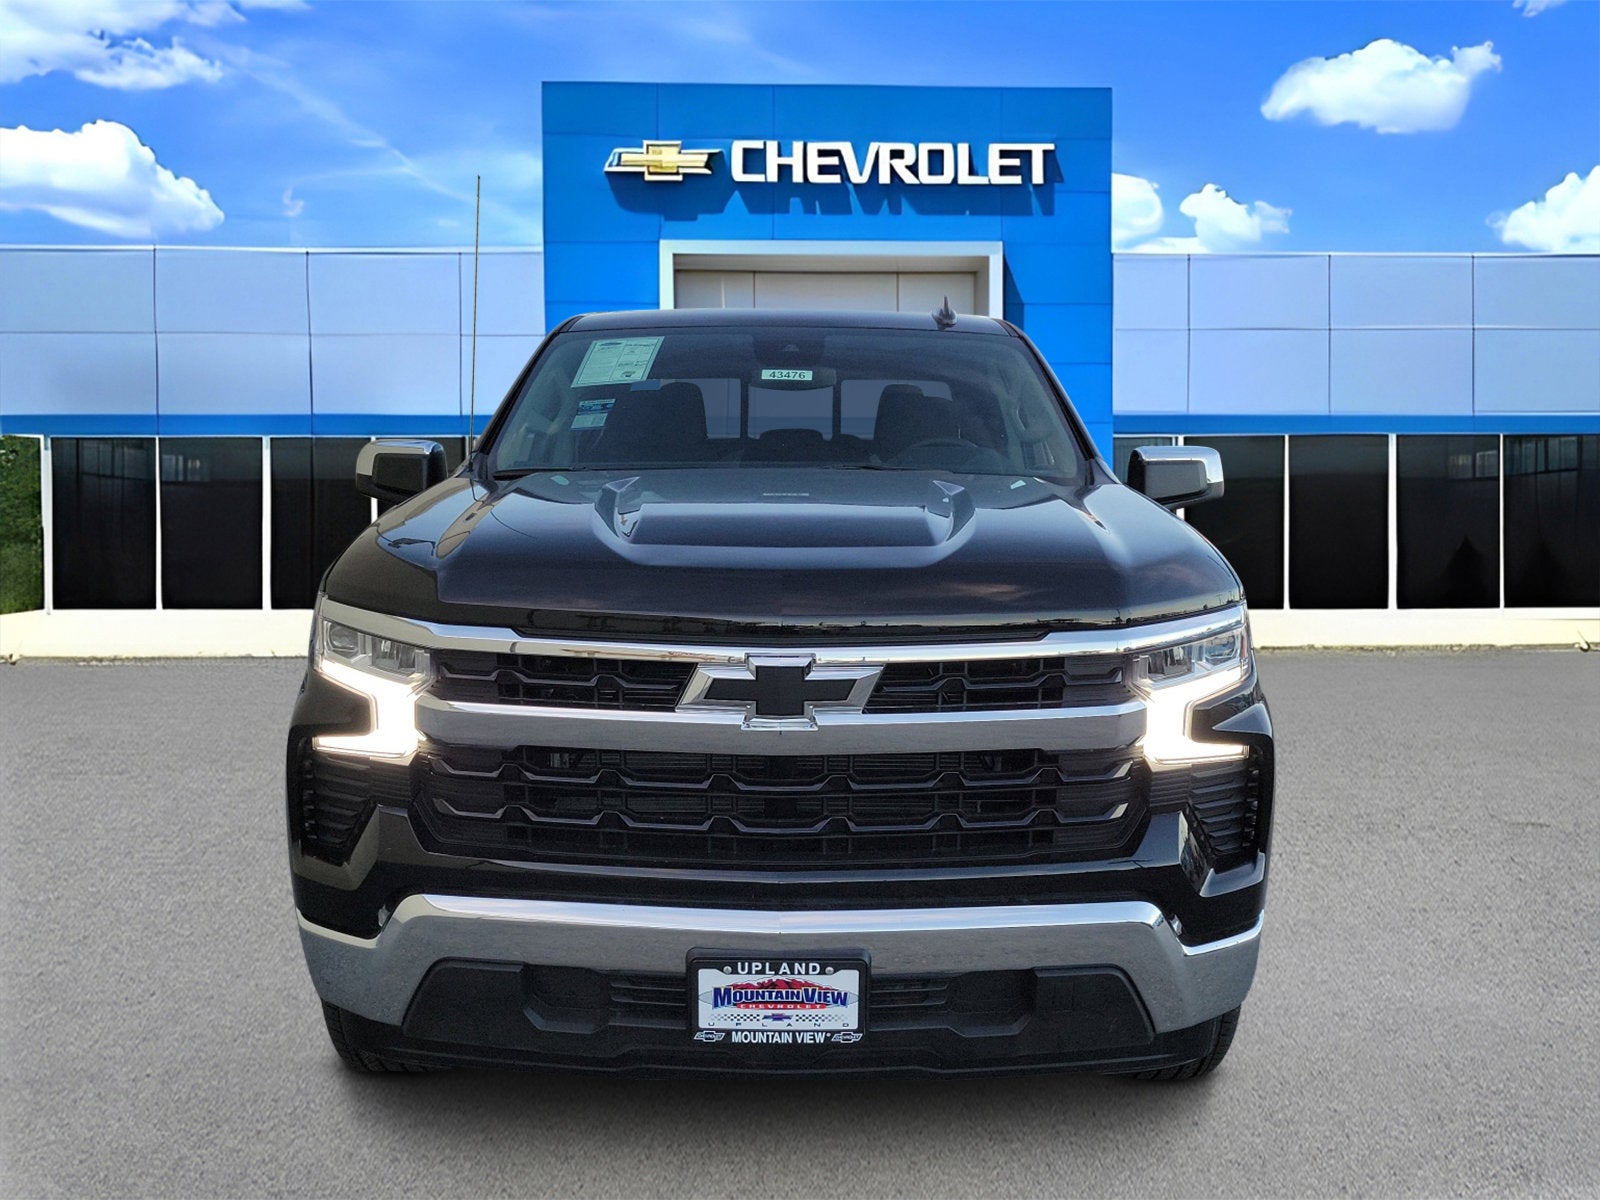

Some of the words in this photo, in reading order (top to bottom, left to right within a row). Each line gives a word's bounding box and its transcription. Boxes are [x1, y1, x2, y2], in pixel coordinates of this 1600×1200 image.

[731, 140, 1055, 184] CHEVROLET
[769, 371, 806, 380] 43476
[737, 962, 821, 975] UPLAND
[731, 1031, 794, 1043] MOUNTAIN
[796, 1032, 826, 1043] VIEW
